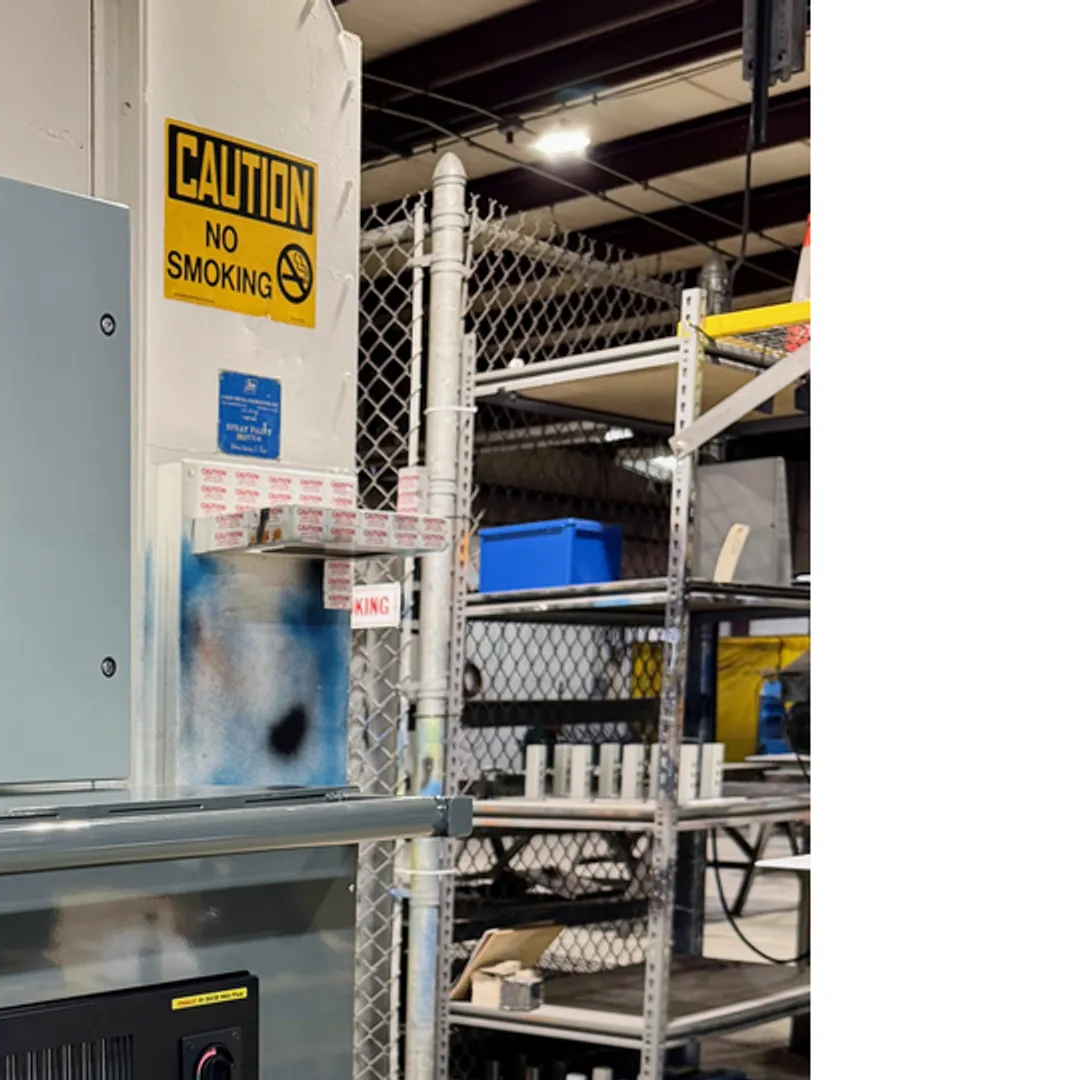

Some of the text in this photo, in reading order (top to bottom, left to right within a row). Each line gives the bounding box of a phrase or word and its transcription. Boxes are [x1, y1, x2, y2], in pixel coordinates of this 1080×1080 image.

[176, 132, 310, 229] CAUTION
[206, 220, 238, 253] NO
[167, 250, 272, 299] SMOKING
